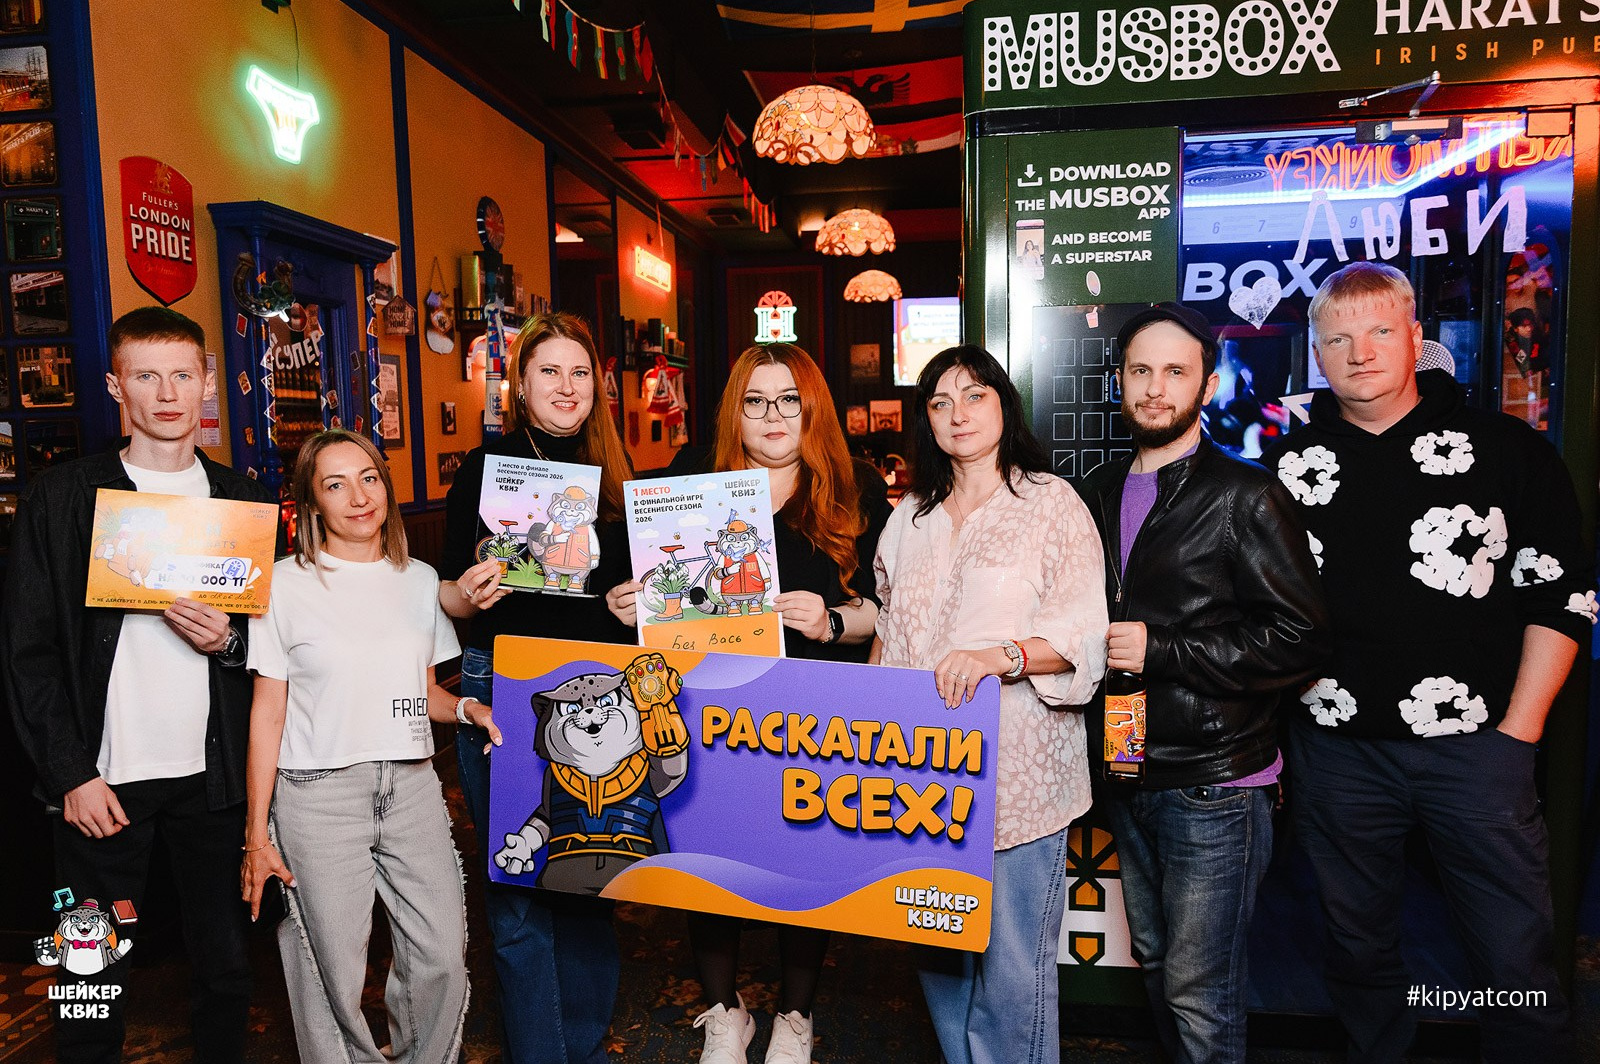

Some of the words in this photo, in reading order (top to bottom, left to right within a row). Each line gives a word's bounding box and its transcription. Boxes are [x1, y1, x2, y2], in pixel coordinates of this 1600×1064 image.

[984, 0, 1341, 91] MUSBOX
[1375, 41, 1499, 65] IRISH
[1050, 162, 1171, 182] DOWNLOAD
[142, 191, 179, 211] FULLER'S
[1015, 199, 1045, 211] THE
[1050, 184, 1170, 209] MUSBOX
[129, 203, 190, 231] LONDON
[1137, 207, 1170, 220] APP
[1212, 222, 1221, 234] 6
[1258, 220, 1266, 232] 7
[1349, 216, 1358, 229] 9
[131, 222, 192, 262] PRIDE
[1051, 232, 1085, 245] AND
[1088, 230, 1152, 244] BECOME
[1051, 253, 1063, 265] A
[1065, 250, 1152, 264] SUPERSTAR
[1182, 257, 1328, 301] BOX
[497, 468, 527, 476] весеннего
[525, 464, 549, 473] финале
[495, 476, 525, 485] ШЕЙКЕР
[725, 478, 761, 489] ШЕЙКЕР
[632, 488, 639, 496] 1
[641, 486, 671, 496] МЕСТО
[639, 494, 685, 506] ФИНАЛЬНОЙ
[686, 493, 704, 501] ИГРЕ
[731, 488, 756, 498] КВИЗ
[634, 505, 674, 515] ВЕСЕННЕГО
[674, 503, 702, 511] СЕЗОНА
[201, 575, 227, 586] 000
[233, 577, 246, 587] ТГ
[672, 635, 695, 650] Без
[1106, 711, 1132, 727] 1
[1132, 698, 1145, 739] МЕСТО
[701, 705, 983, 776] РАСКАТАЛИ
[782, 767, 975, 843] ВСЕХ!
[894, 886, 980, 913] ШЕЙКЕР
[907, 908, 963, 934] КВИЗ
